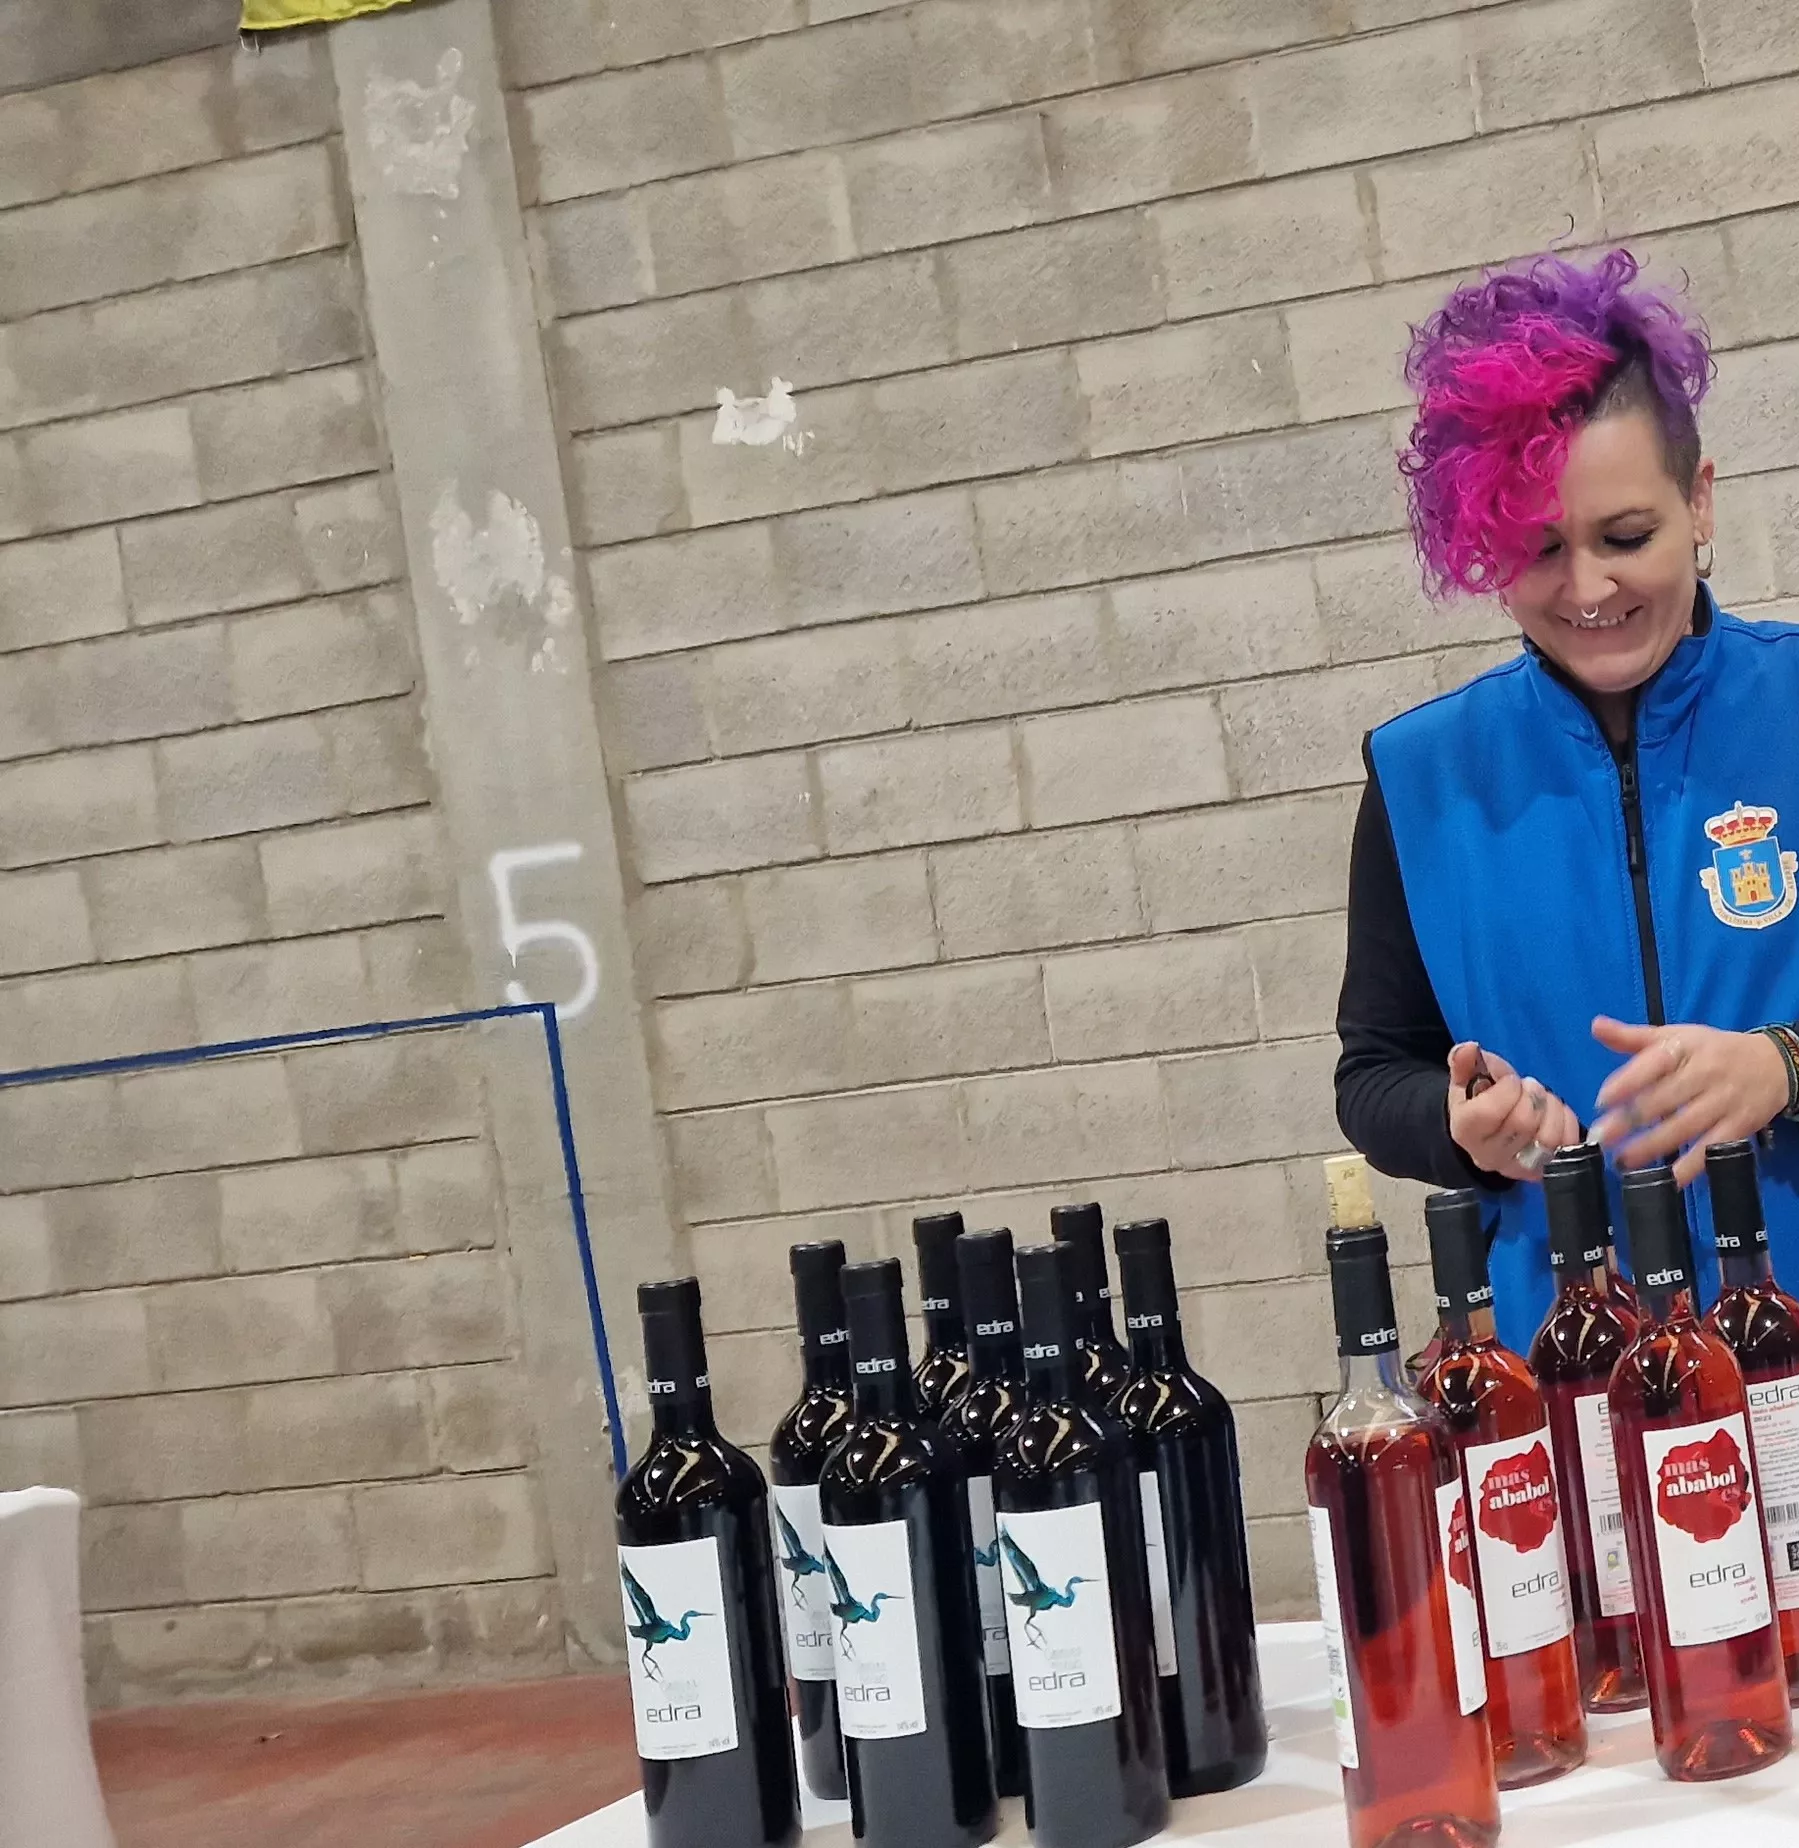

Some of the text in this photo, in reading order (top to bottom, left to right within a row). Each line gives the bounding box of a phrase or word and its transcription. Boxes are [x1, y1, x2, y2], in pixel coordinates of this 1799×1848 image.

[489, 841, 598, 1020] 5
[1646, 1267, 1684, 1286] edra
[976, 1320, 1014, 1336] edra
[1127, 1313, 1163, 1329] edra
[1023, 1343, 1060, 1359] edra
[856, 1357, 897, 1374] edra
[647, 1378, 676, 1394] dra
[1666, 1464, 1736, 1497] ababol
[1489, 1475, 1550, 1510] ababol
[1511, 1570, 1560, 1598] edra
[1689, 1563, 1746, 1588] edra
[1028, 1671, 1086, 1691] edra
[844, 1684, 891, 1702] edra
[646, 1703, 701, 1723] edra
